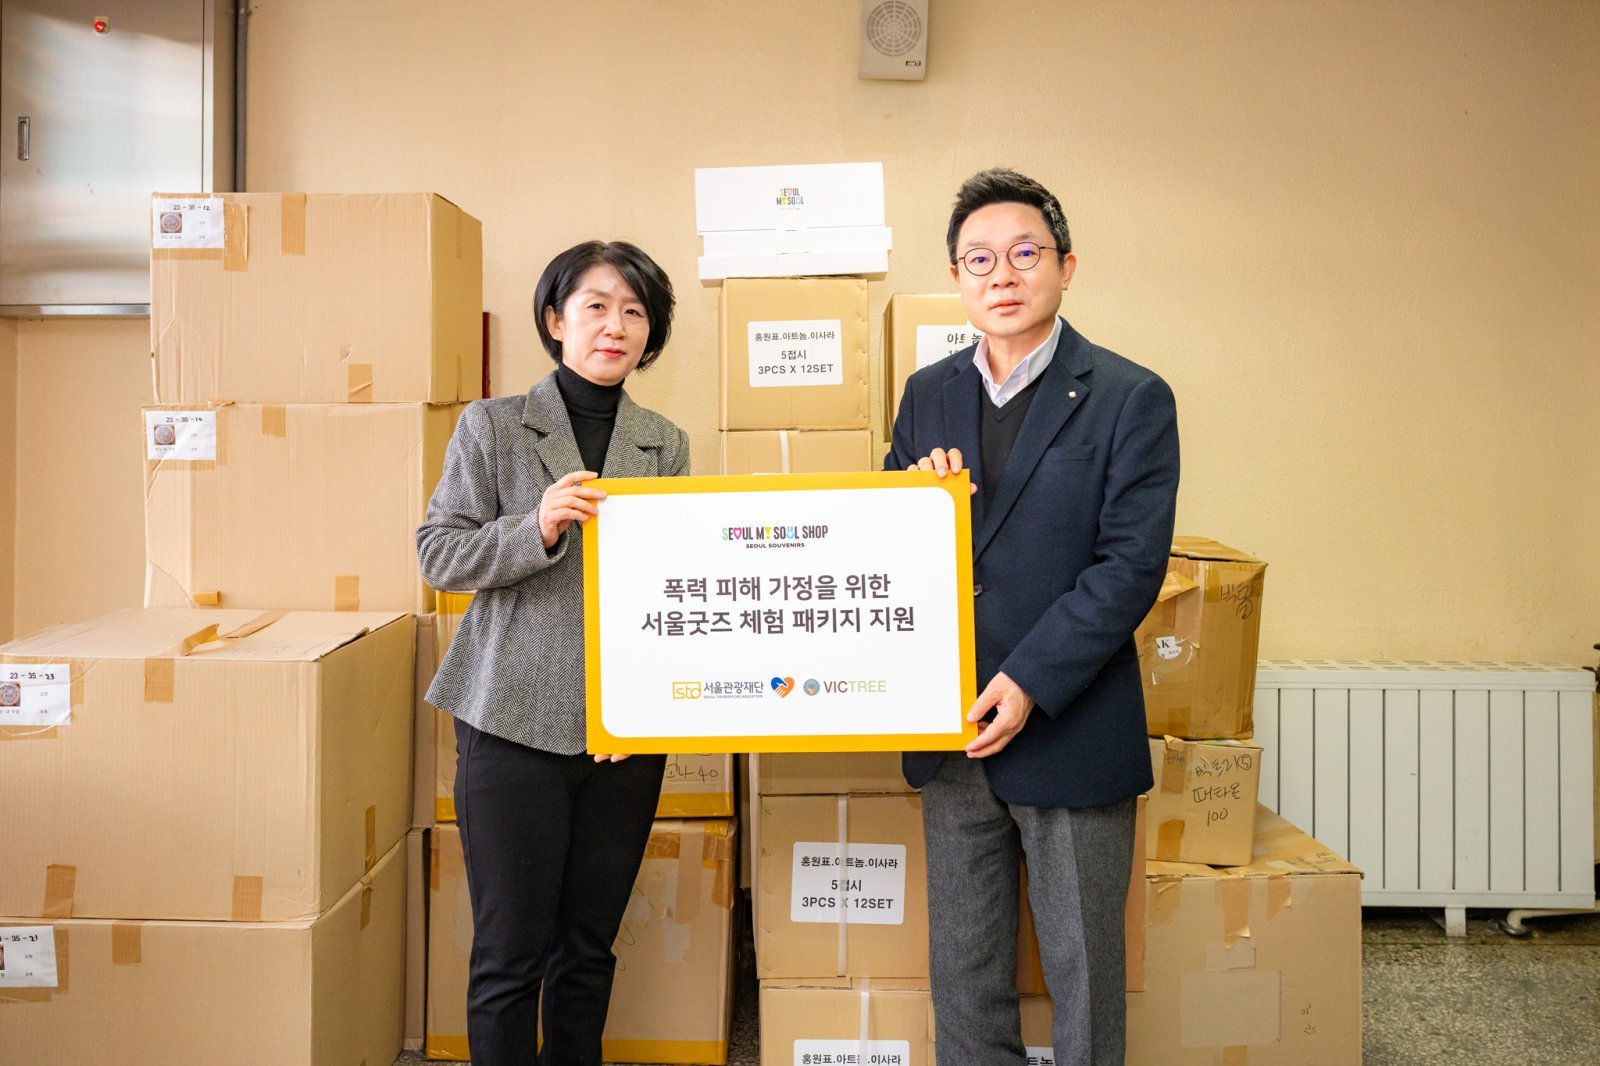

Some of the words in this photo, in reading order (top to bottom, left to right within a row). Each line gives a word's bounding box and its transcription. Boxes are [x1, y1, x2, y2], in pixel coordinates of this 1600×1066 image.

[781, 349, 807, 360] 5접시
[758, 365, 786, 374] 3PCS
[790, 365, 797, 374] X
[801, 363, 834, 373] 12SET
[722, 526, 754, 541] SEOUL
[773, 525, 800, 540] SOUL
[802, 525, 828, 539] SHOP
[663, 577, 708, 603] 폭력
[716, 576, 761, 602] 피해
[769, 574, 838, 602] 가정을
[845, 573, 891, 600] 위한
[641, 609, 733, 637] 서울굿즈
[739, 608, 784, 635] 체험
[792, 607, 861, 634] 패키지
[869, 606, 915, 632] 지원
[10, 672, 19, 680] 23
[28, 672, 37, 680] 35
[703, 681, 764, 694] 서울관광재단
[823, 680, 888, 693] VICTREE
[699, 765, 719, 782] 40
[1206, 807, 1229, 827] 100
[802, 897, 836, 908] 3PCS
[854, 898, 894, 909] 12SET
[29, 934, 38, 942] 21
[802, 1053, 902, 1065] 홍원표.아트.이사라
